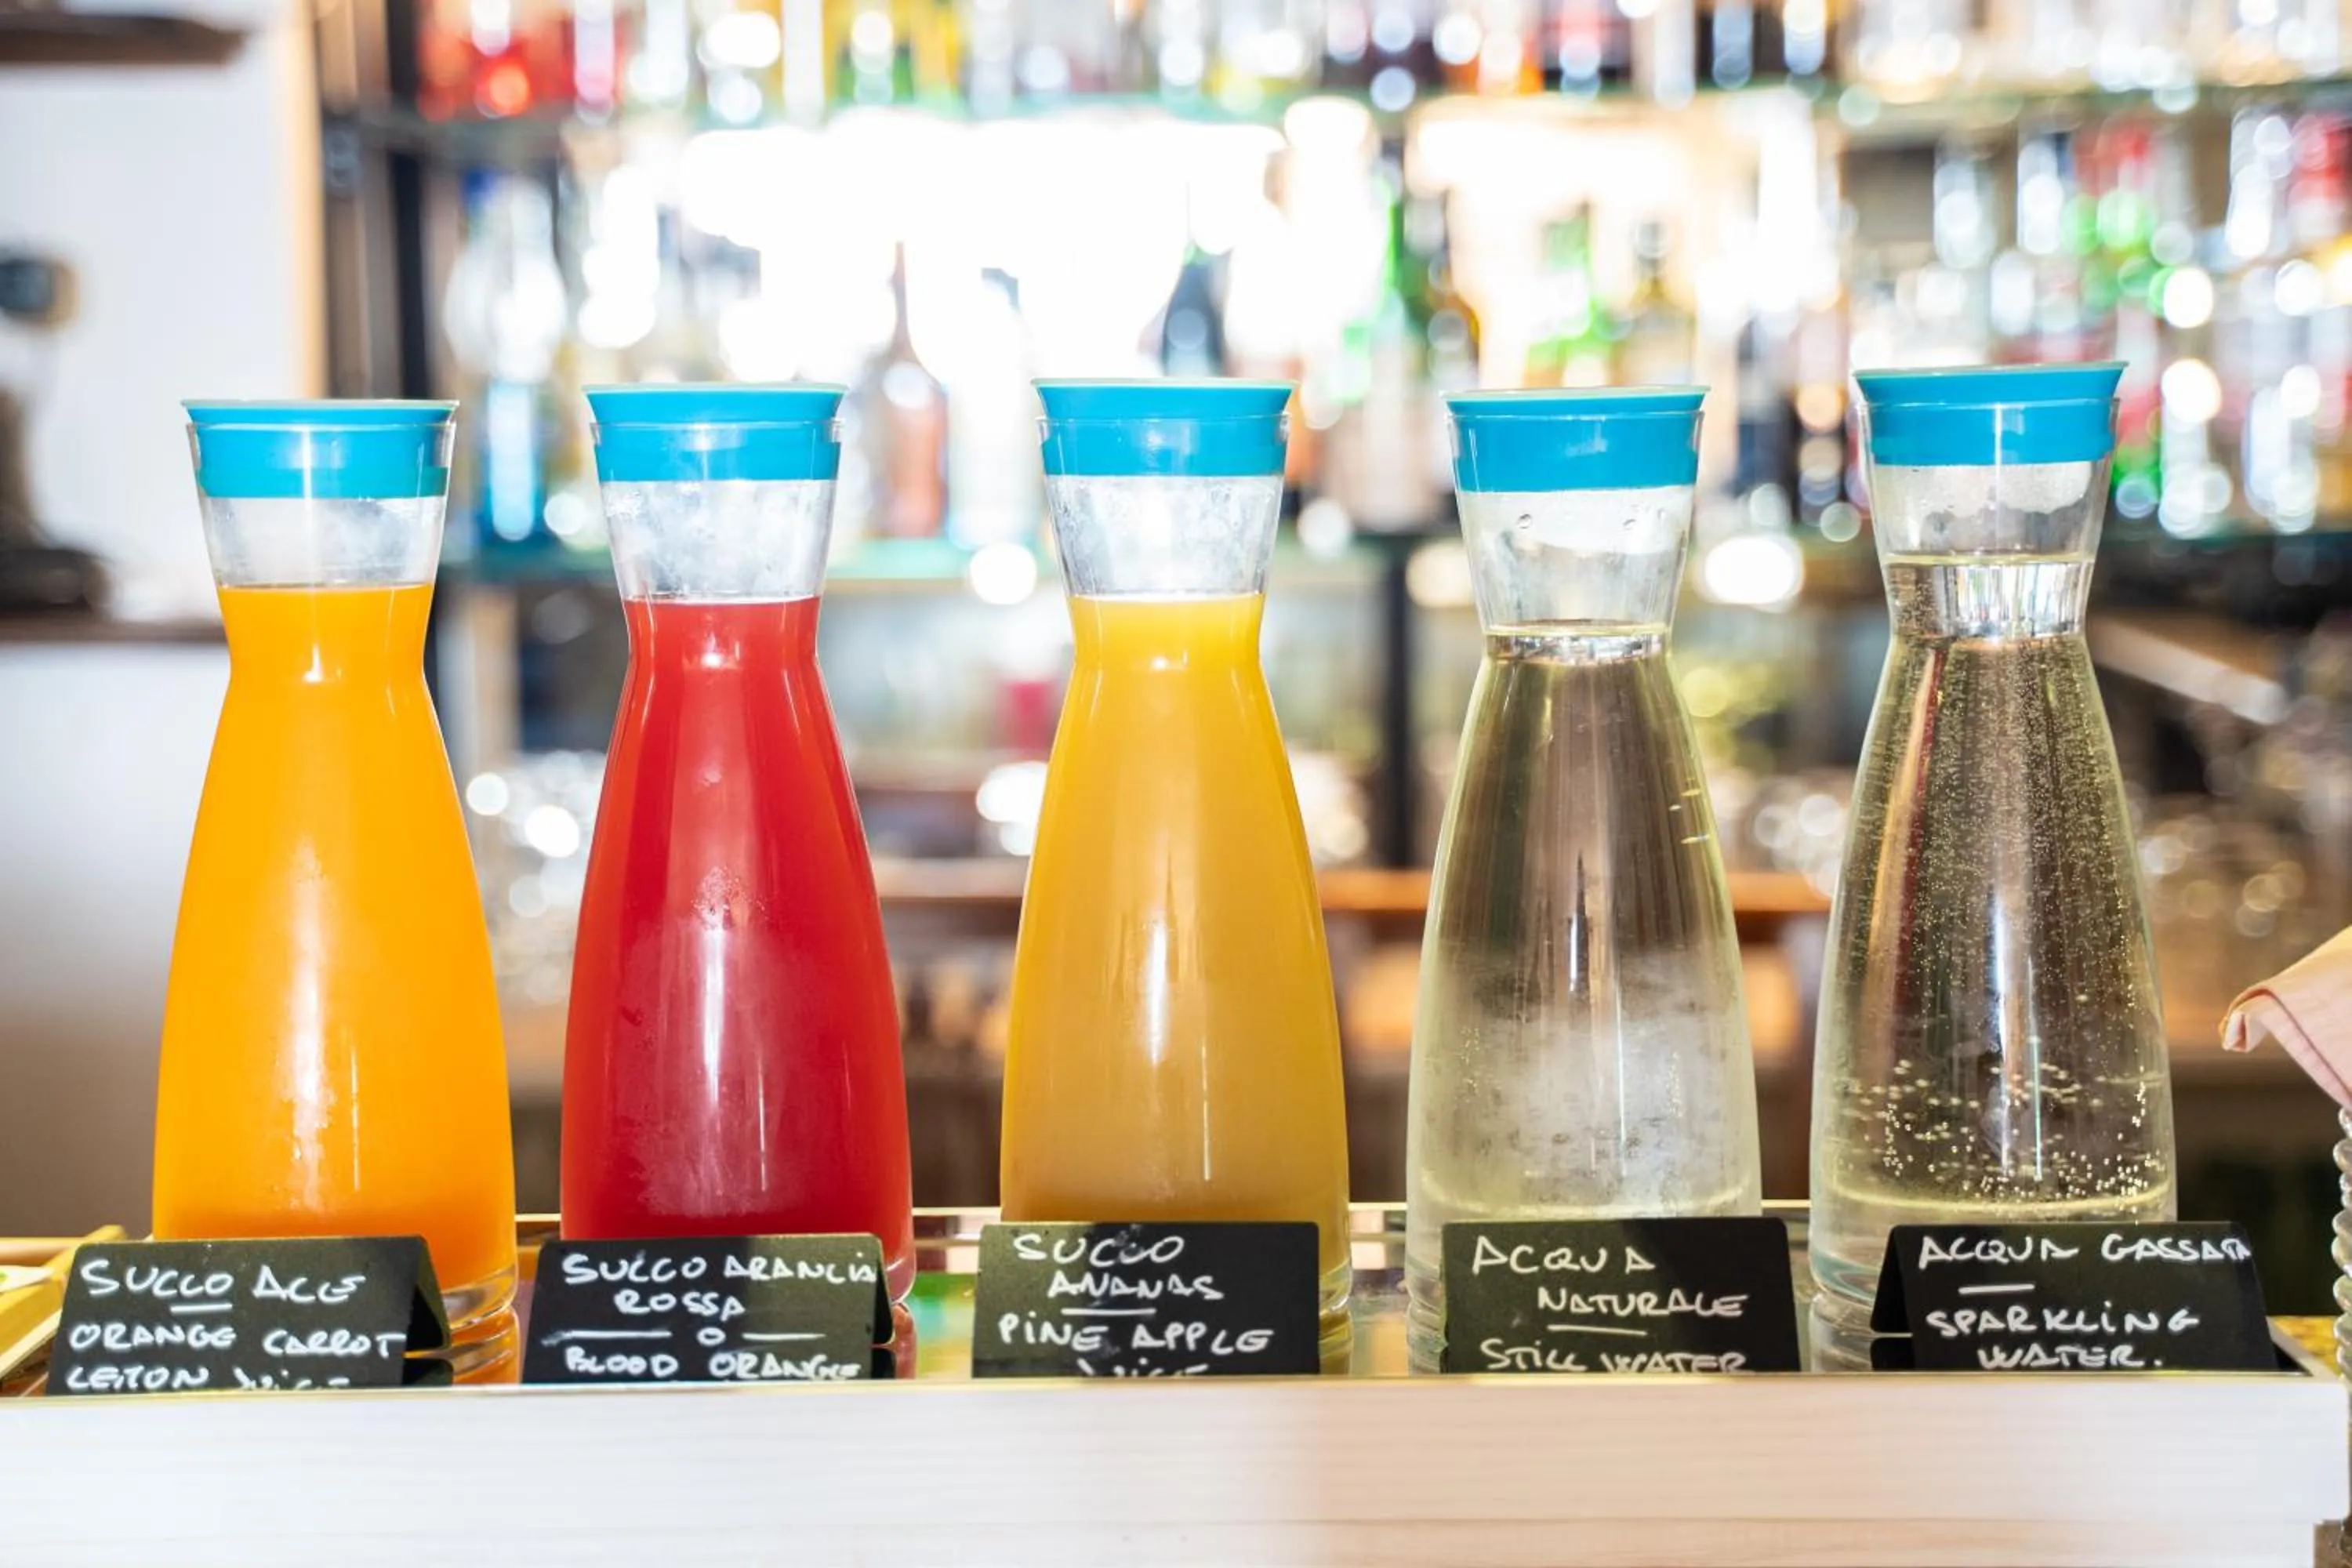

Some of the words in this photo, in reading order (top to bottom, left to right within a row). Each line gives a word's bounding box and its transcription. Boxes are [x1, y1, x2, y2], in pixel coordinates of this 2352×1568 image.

[562, 1253, 707, 1284] SUCCO
[1472, 1235, 1656, 1275] ACQUA
[1918, 1235, 2080, 1270] ACQUA
[80, 1258, 234, 1298] SUCCO
[252, 1265, 366, 1304] ACE
[1046, 1269, 1224, 1300] ANANAS
[613, 1288, 746, 1322] ROSSA
[1537, 1286, 1748, 1317] NATURALE
[69, 1322, 237, 1351] ORANGE
[263, 1329, 407, 1358] CARROT
[1131, 1322, 1274, 1356] APPLE
[565, 1345, 679, 1378] BLOOD
[1597, 1352, 1757, 1376] WATER
